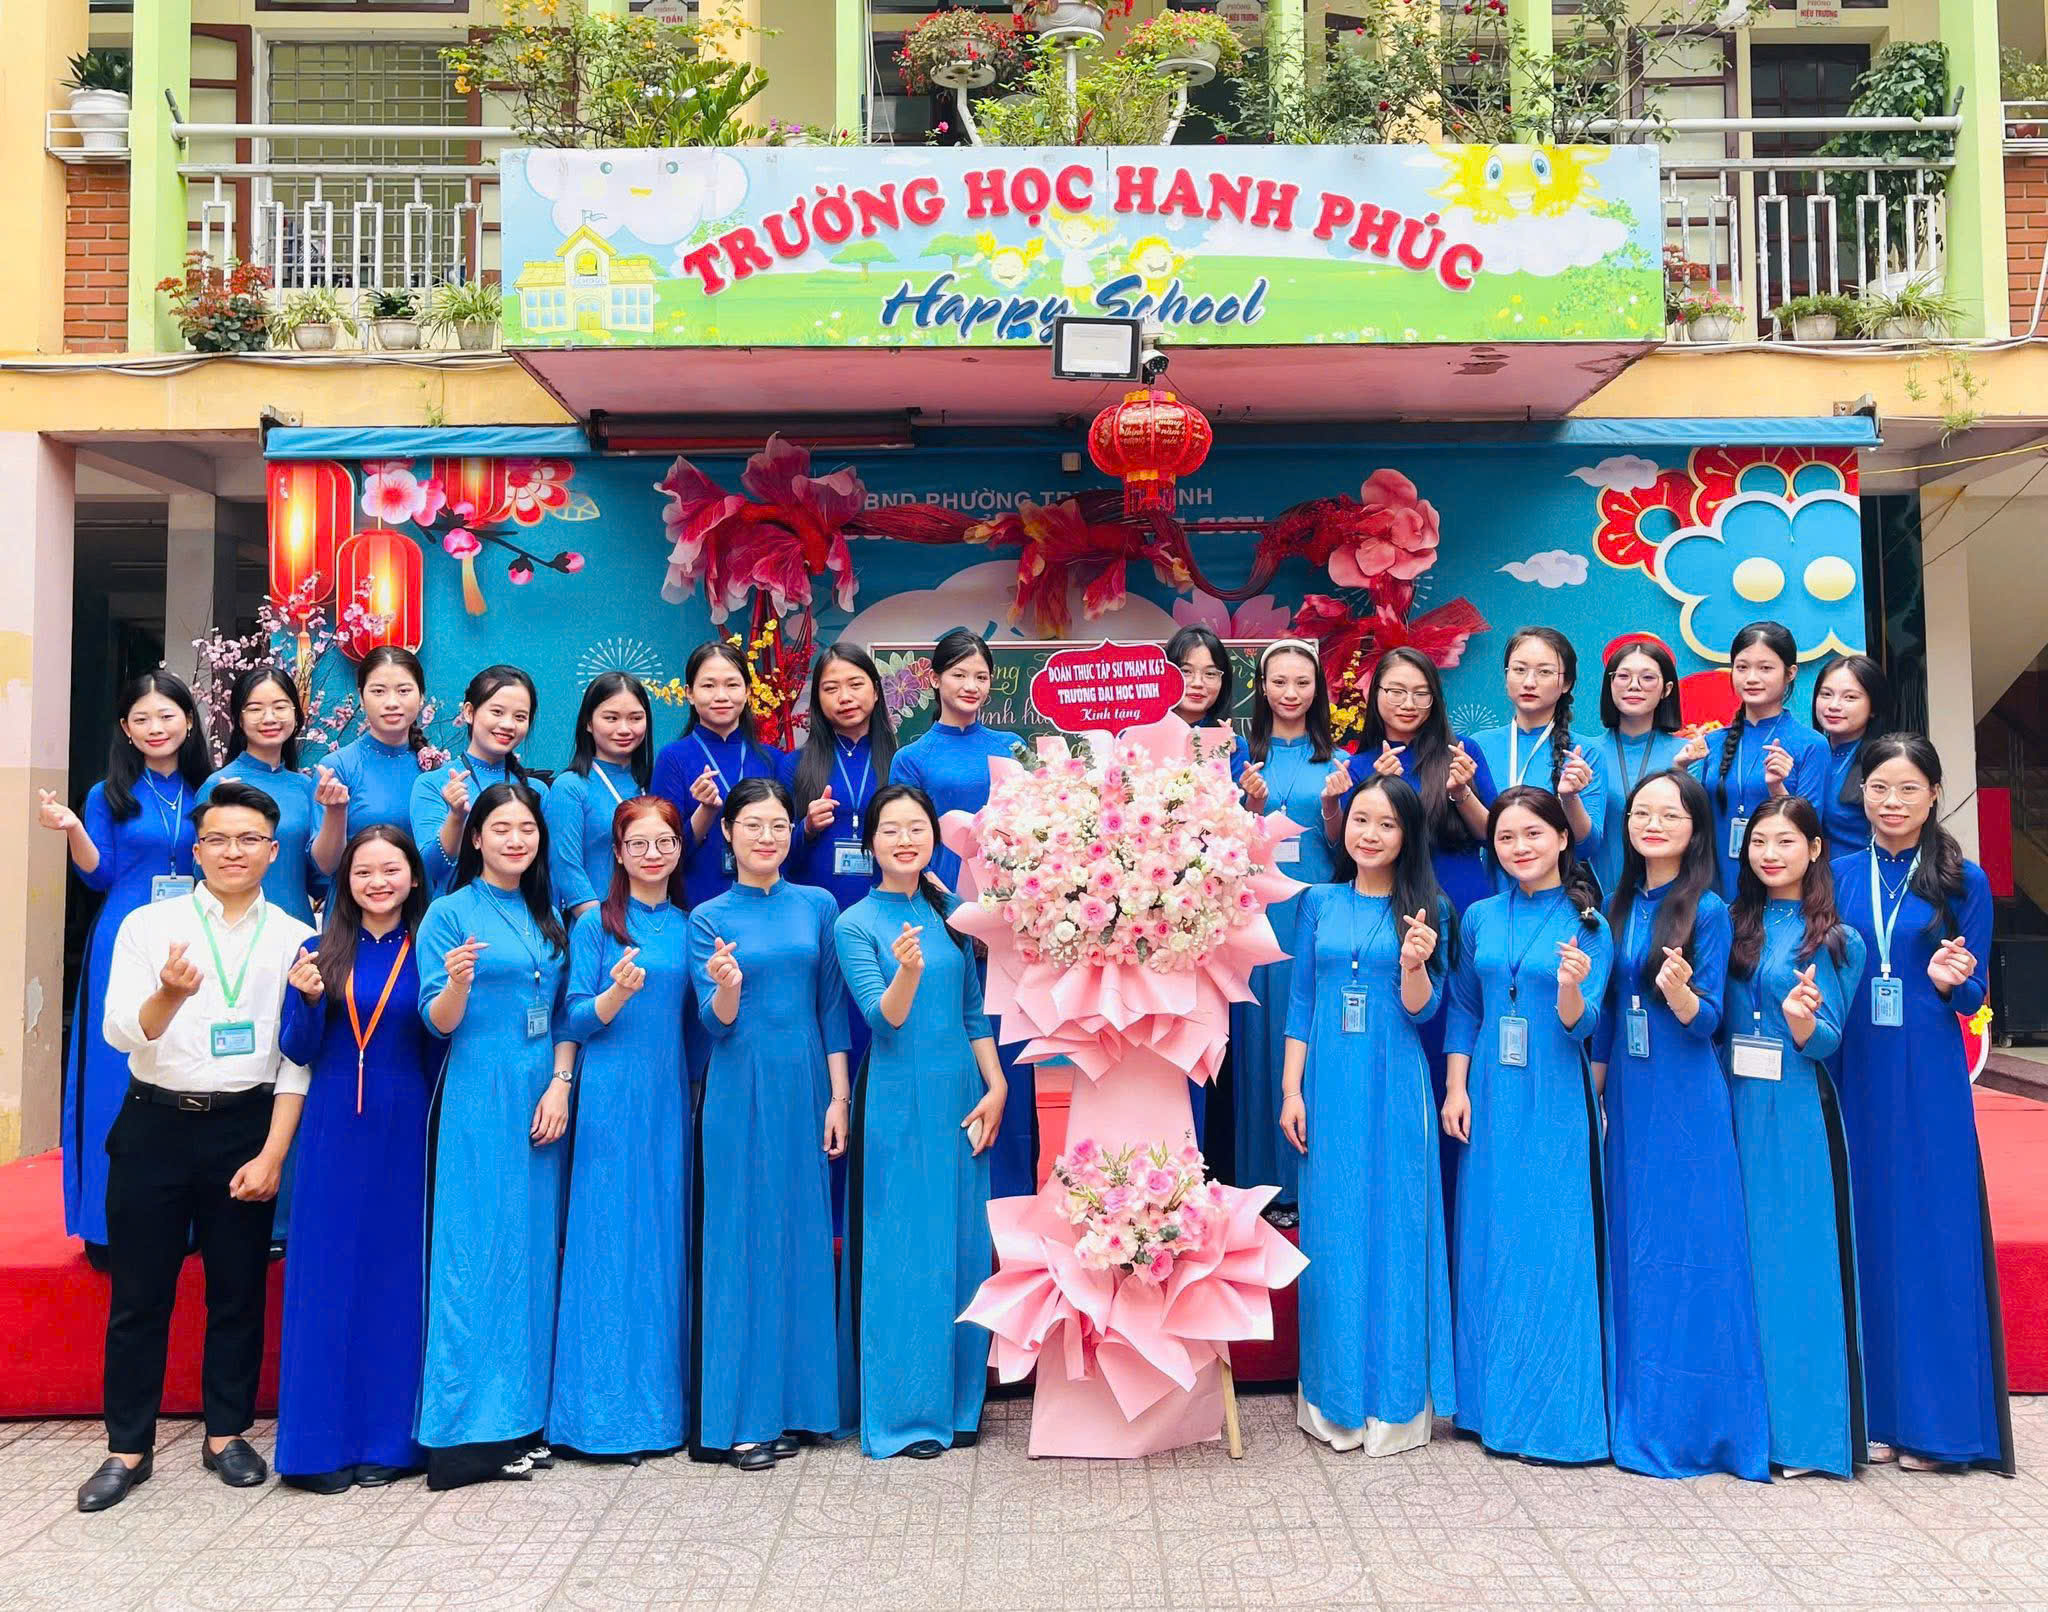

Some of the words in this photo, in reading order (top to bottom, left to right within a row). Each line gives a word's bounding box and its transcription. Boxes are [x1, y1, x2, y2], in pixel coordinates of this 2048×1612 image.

[683, 176, 945, 295] TRƯỜNG
[964, 165, 1093, 227] HỌC
[1114, 166, 1299, 231] HANH
[1313, 192, 1483, 291] PHÚC
[882, 273, 1069, 343] Happy
[1096, 274, 1266, 325] School
[1058, 685, 1096, 704] TRƯỜNG
[1116, 685, 1134, 702] HỌC
[1136, 683, 1160, 699] VINH
[1073, 663, 1095, 683] THỰC
[1096, 660, 1111, 682] TẬP
[1113, 662, 1123, 680] SƯ
[1124, 661, 1148, 680] PHẠM
[1148, 659, 1165, 676] K63
